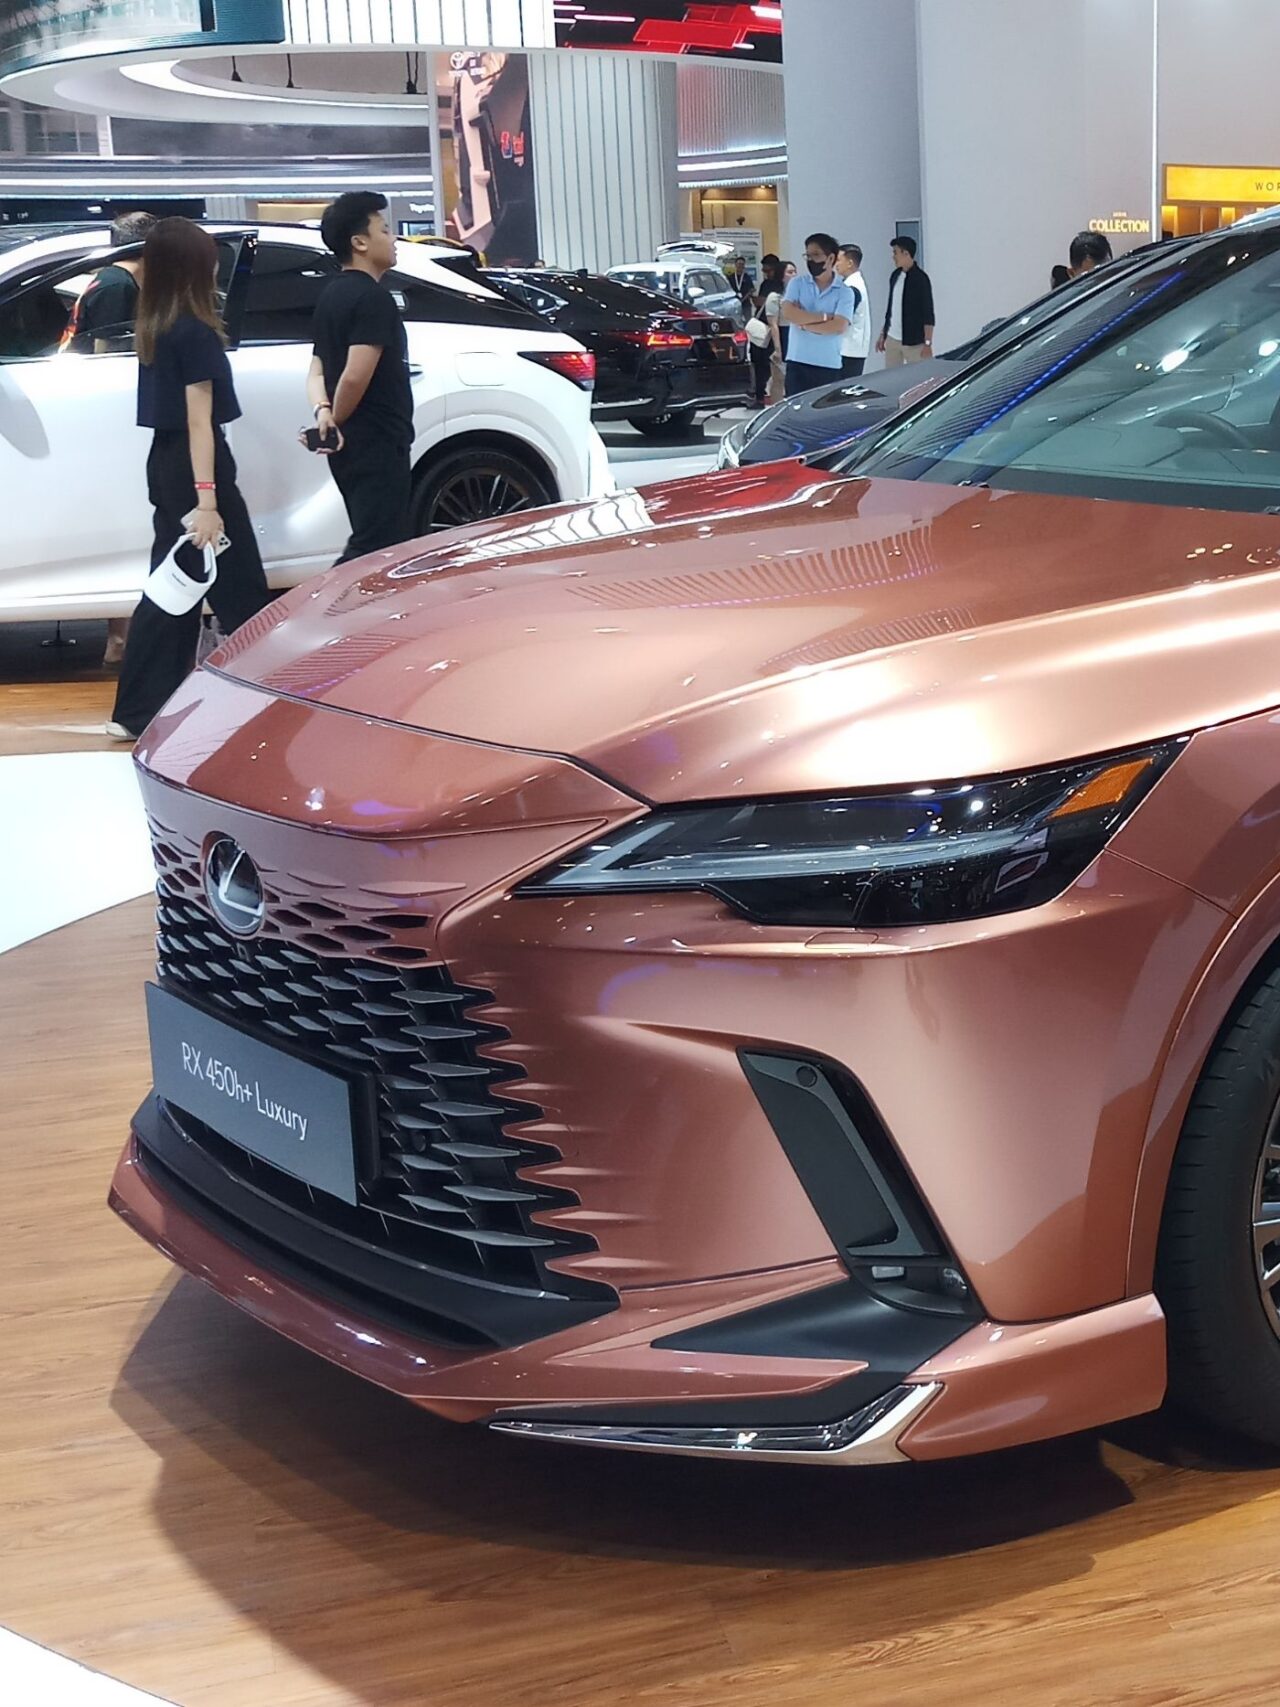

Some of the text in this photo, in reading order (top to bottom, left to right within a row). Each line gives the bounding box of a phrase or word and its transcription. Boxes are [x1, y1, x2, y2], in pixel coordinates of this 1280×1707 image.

[1088, 219, 1150, 233] COLLECTION
[181, 1041, 308, 1142] RX 450h+ Luxury
